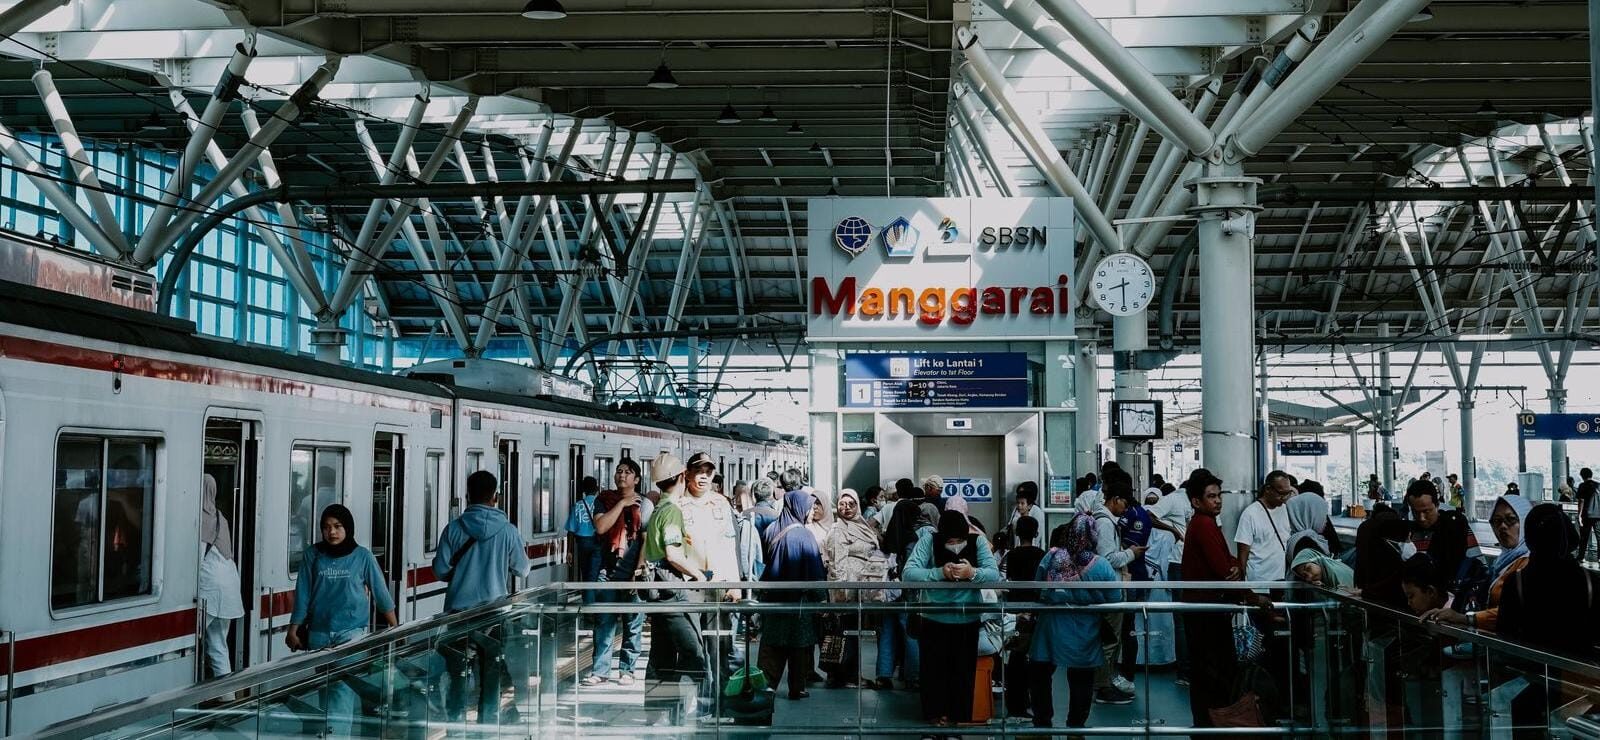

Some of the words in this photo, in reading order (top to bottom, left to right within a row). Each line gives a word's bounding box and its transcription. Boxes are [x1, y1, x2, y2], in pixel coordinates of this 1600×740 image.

[982, 226, 1047, 245] SBSN
[812, 274, 1069, 325] Manggarai
[913, 358, 931, 368] Lift
[932, 358, 944, 368] ke
[946, 358, 976, 368] Lantai
[978, 359, 984, 367] 1
[858, 388, 864, 399] 1
[1520, 414, 1534, 424] 10
